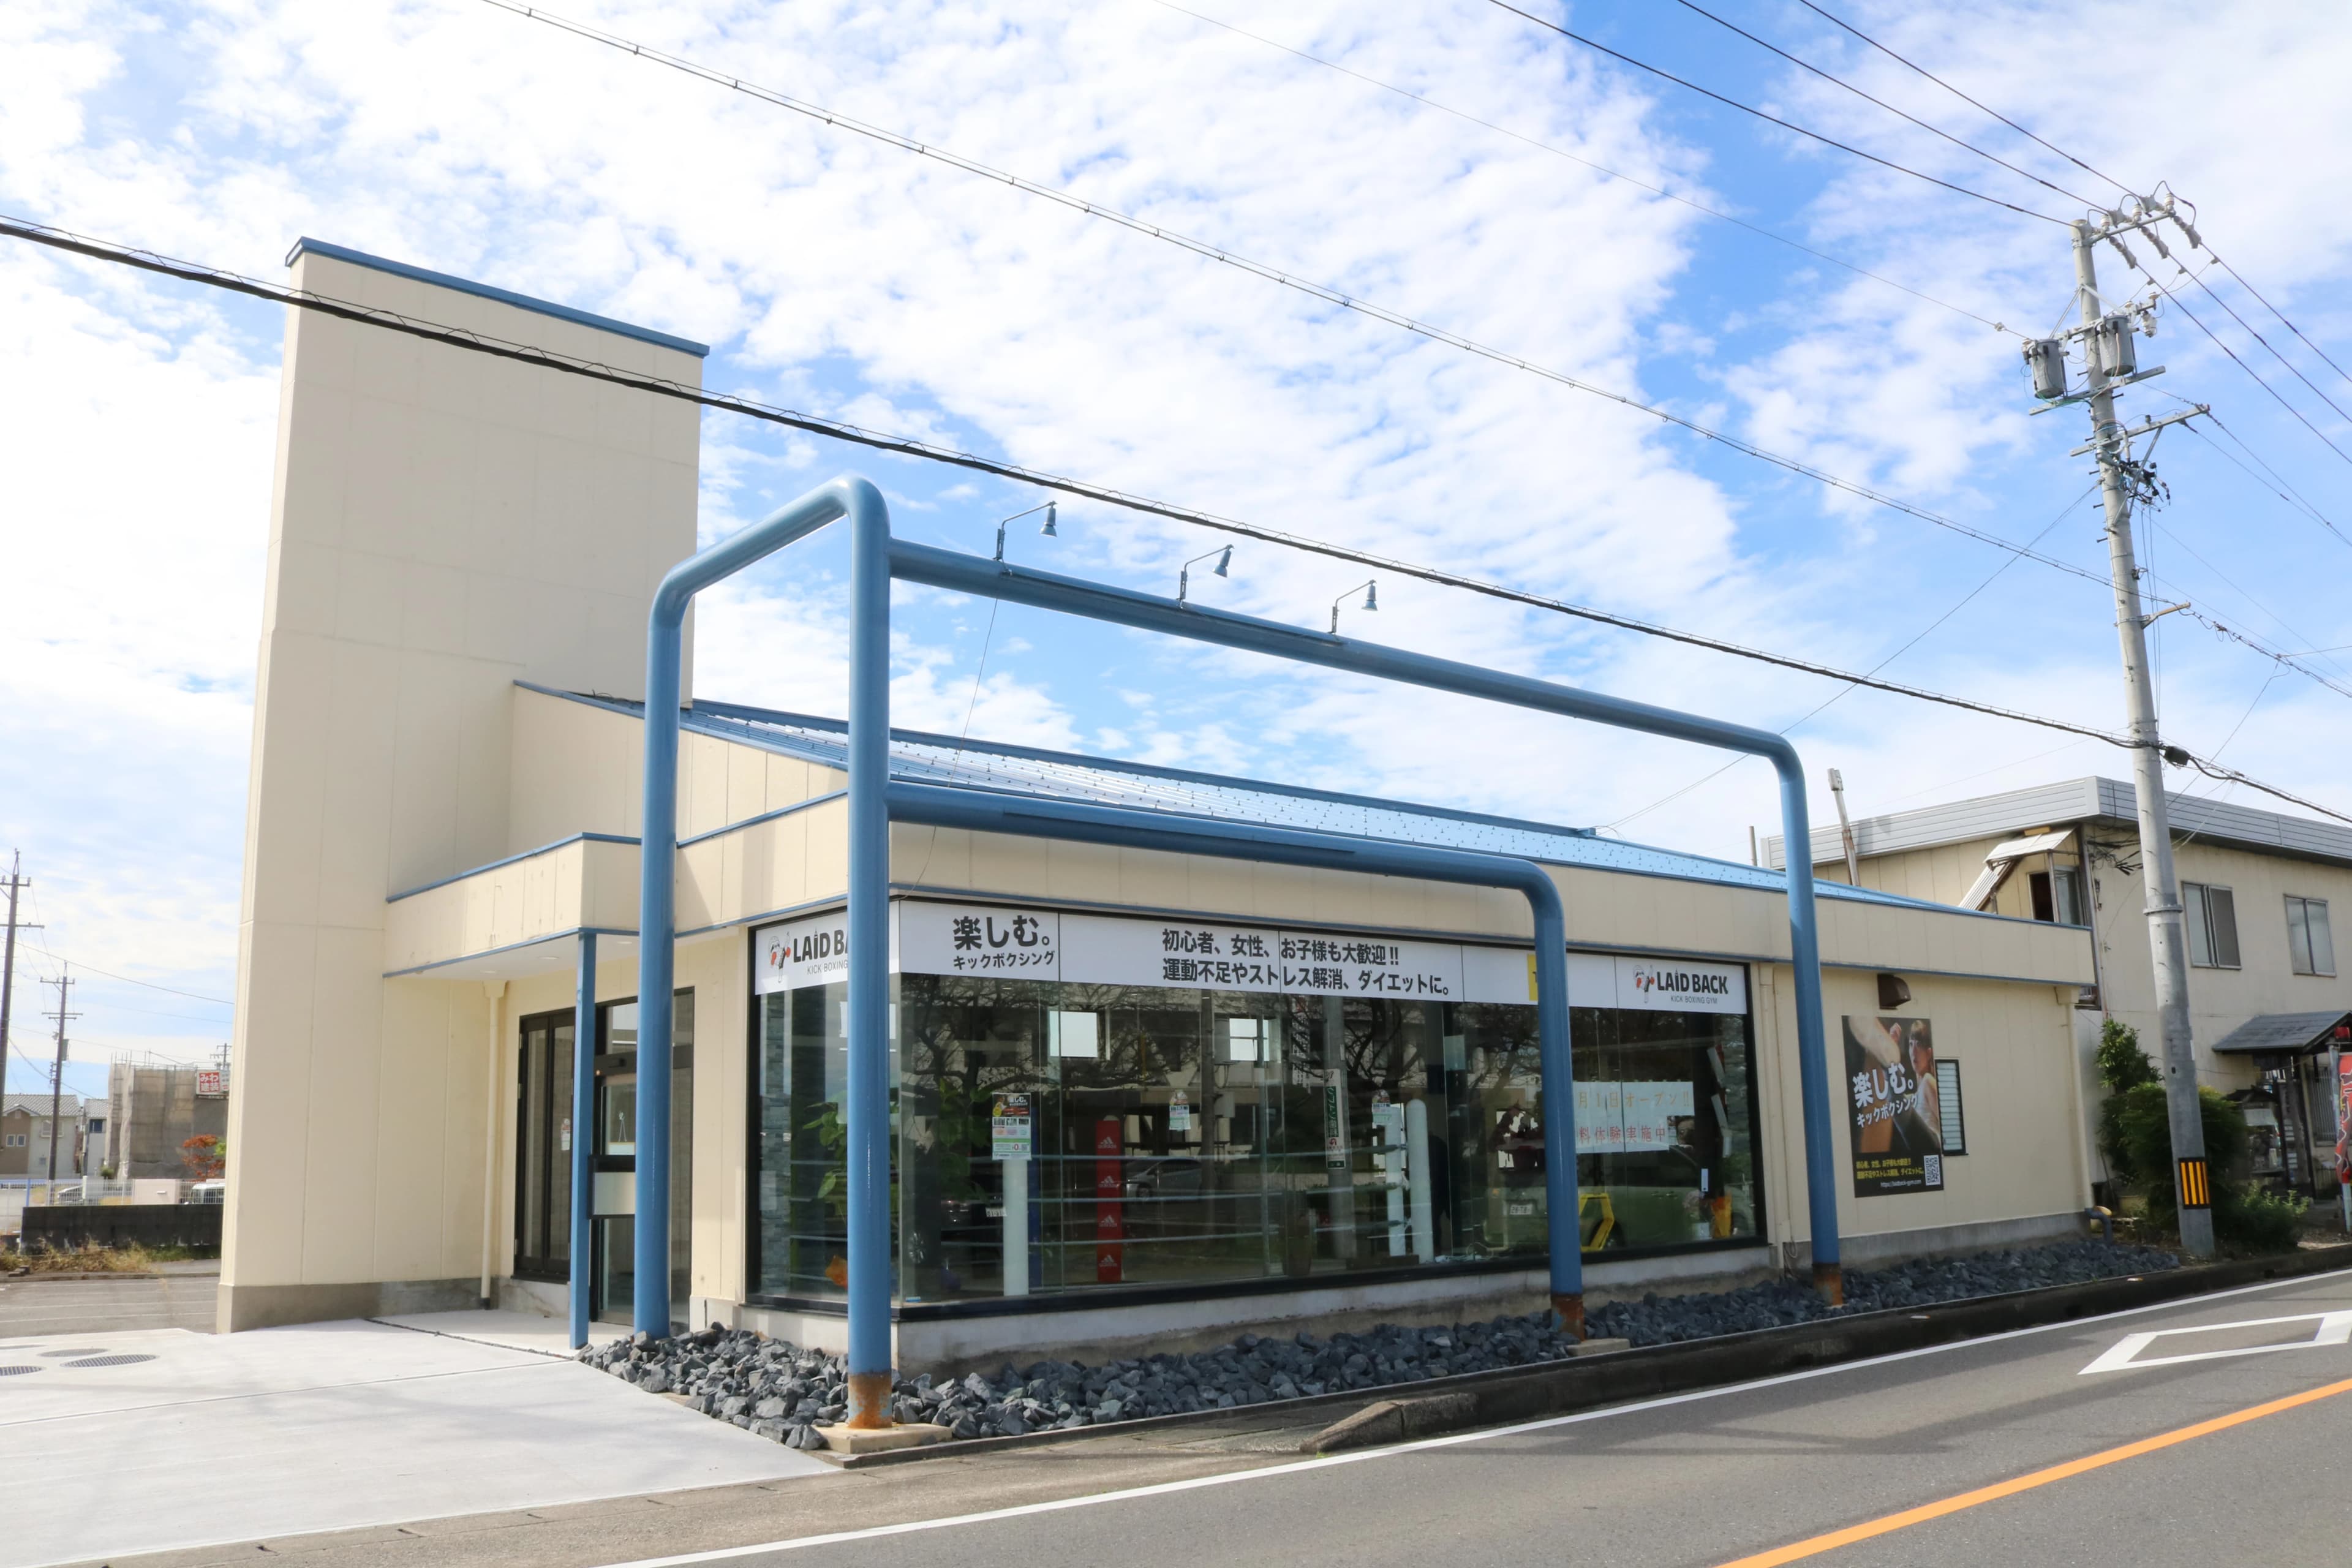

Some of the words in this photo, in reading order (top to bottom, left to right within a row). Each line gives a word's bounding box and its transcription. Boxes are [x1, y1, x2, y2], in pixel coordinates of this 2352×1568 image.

[793, 927, 831, 963] LAID
[834, 930, 848, 956] B
[953, 915, 1052, 951] 楽しむ。
[1162, 929, 1398, 965] 初心者、女性、お子様も大歓迎!!
[807, 963, 822, 975] KICK
[824, 960, 848, 971] BOXING
[953, 950, 1055, 971] キックボクシング
[1163, 958, 1450, 995] 運動不足やストレス解消、ダイエットに。
[1657, 968, 1690, 992] LAID
[1692, 973, 1728, 995] BACK
[1670, 995, 1684, 1003] KICK
[1685, 995, 1705, 1004] BOXING
[1853, 1063, 1914, 1108] 楽しむ。
